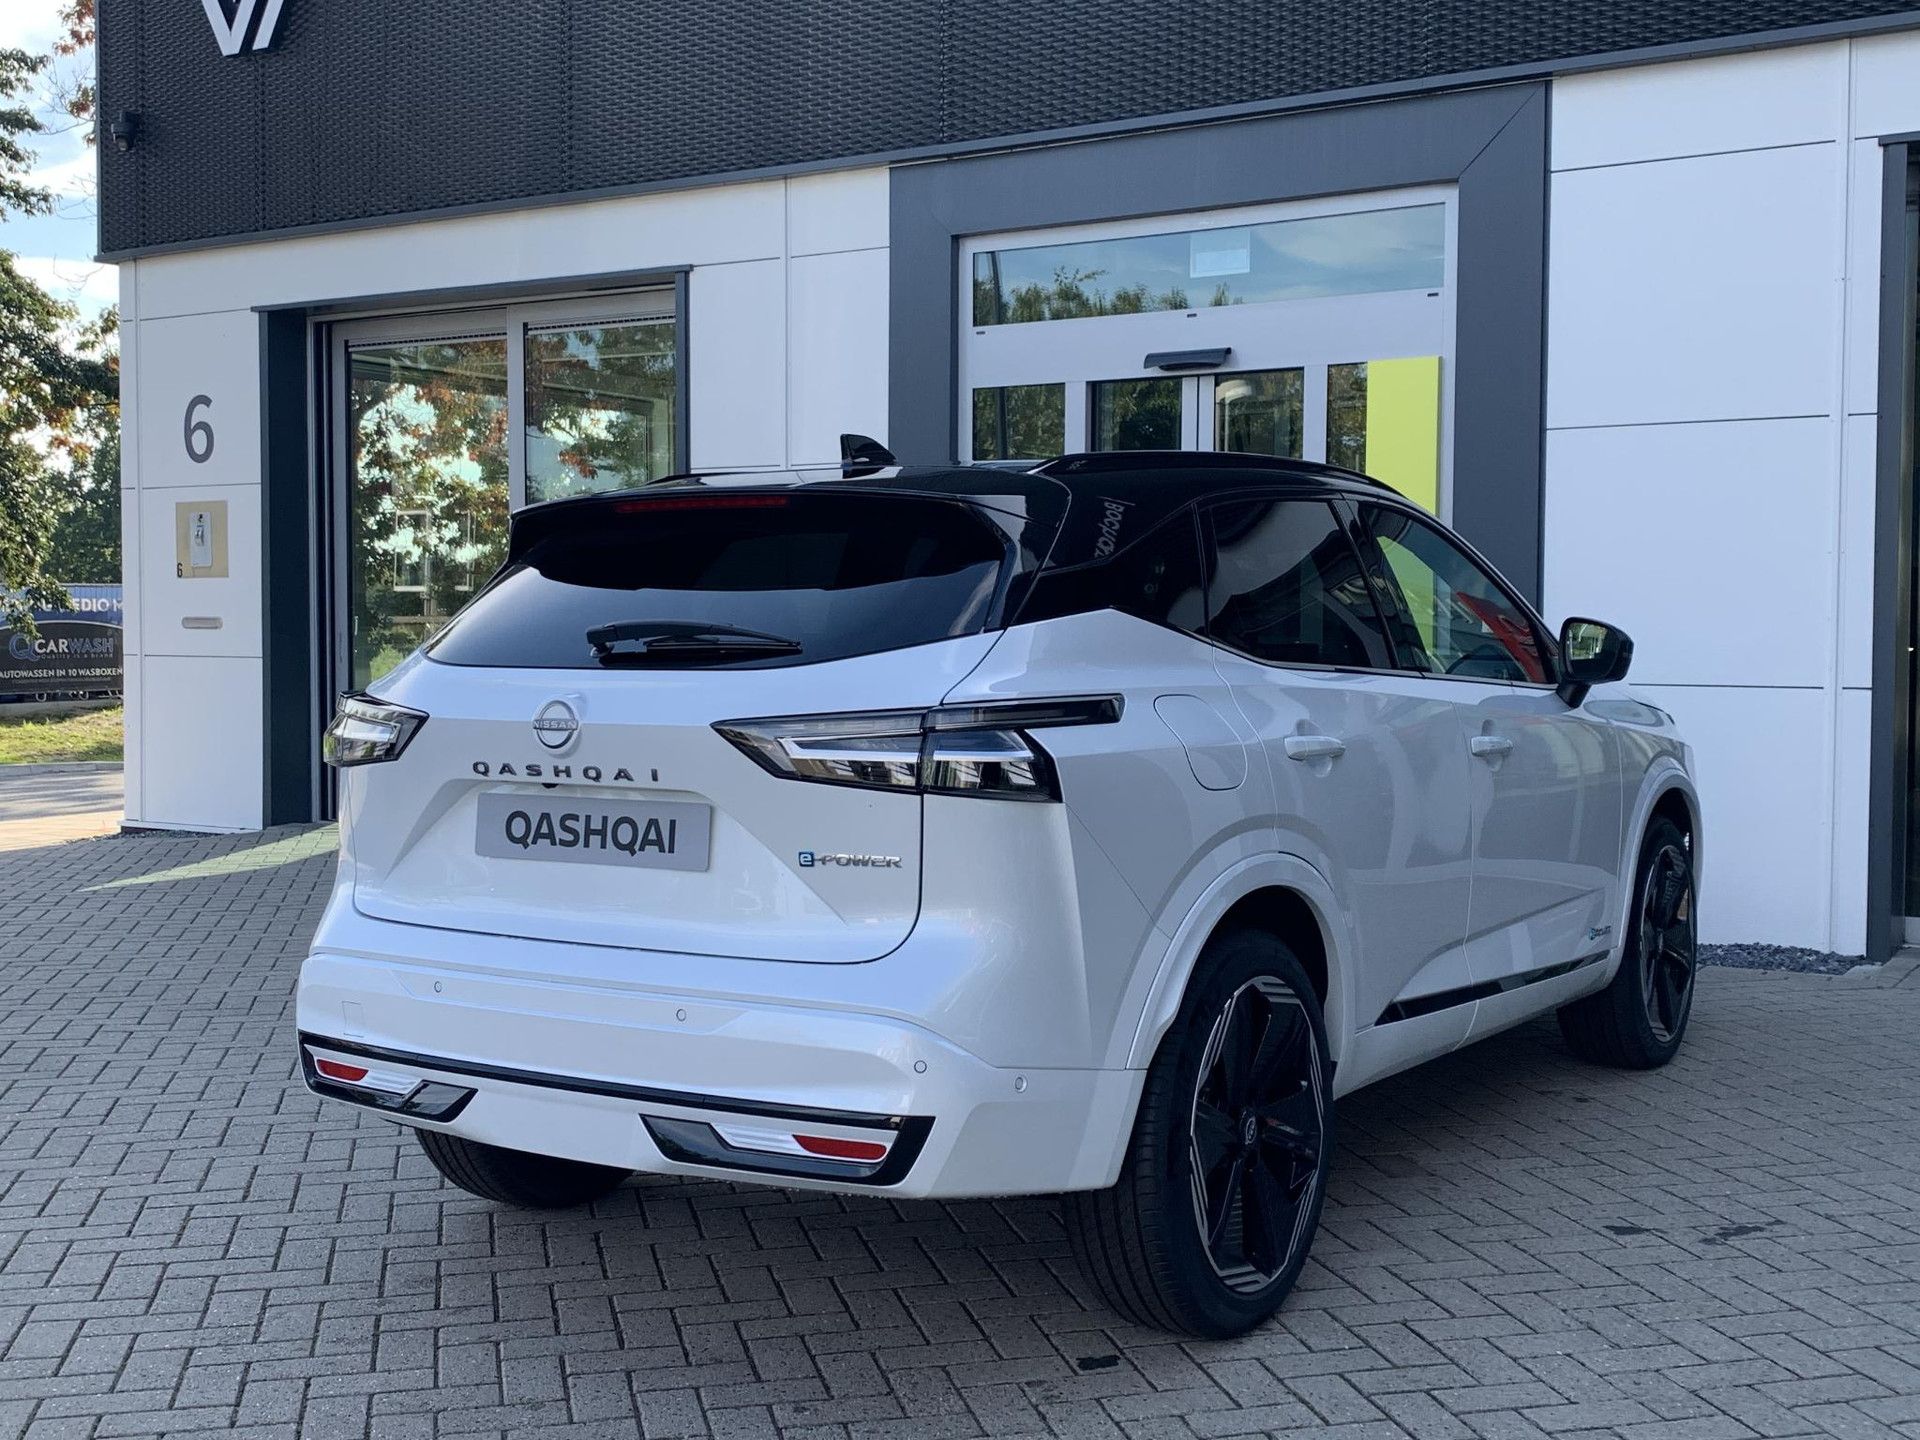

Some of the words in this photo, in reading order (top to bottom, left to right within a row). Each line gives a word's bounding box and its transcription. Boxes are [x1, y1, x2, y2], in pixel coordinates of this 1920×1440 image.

[184, 394, 215, 464] 6
[176, 562, 184, 578] 6
[0, 668, 54, 679] AUTOWASSEN
[56, 668, 66, 677] IN
[68, 668, 77, 677] 10
[79, 667, 123, 677] WASBOXEN
[534, 719, 577, 730] NISSAN
[472, 761, 659, 782] QASHQAI
[505, 810, 677, 857] QASHQAI
[799, 852, 902, 868] e-POWER
